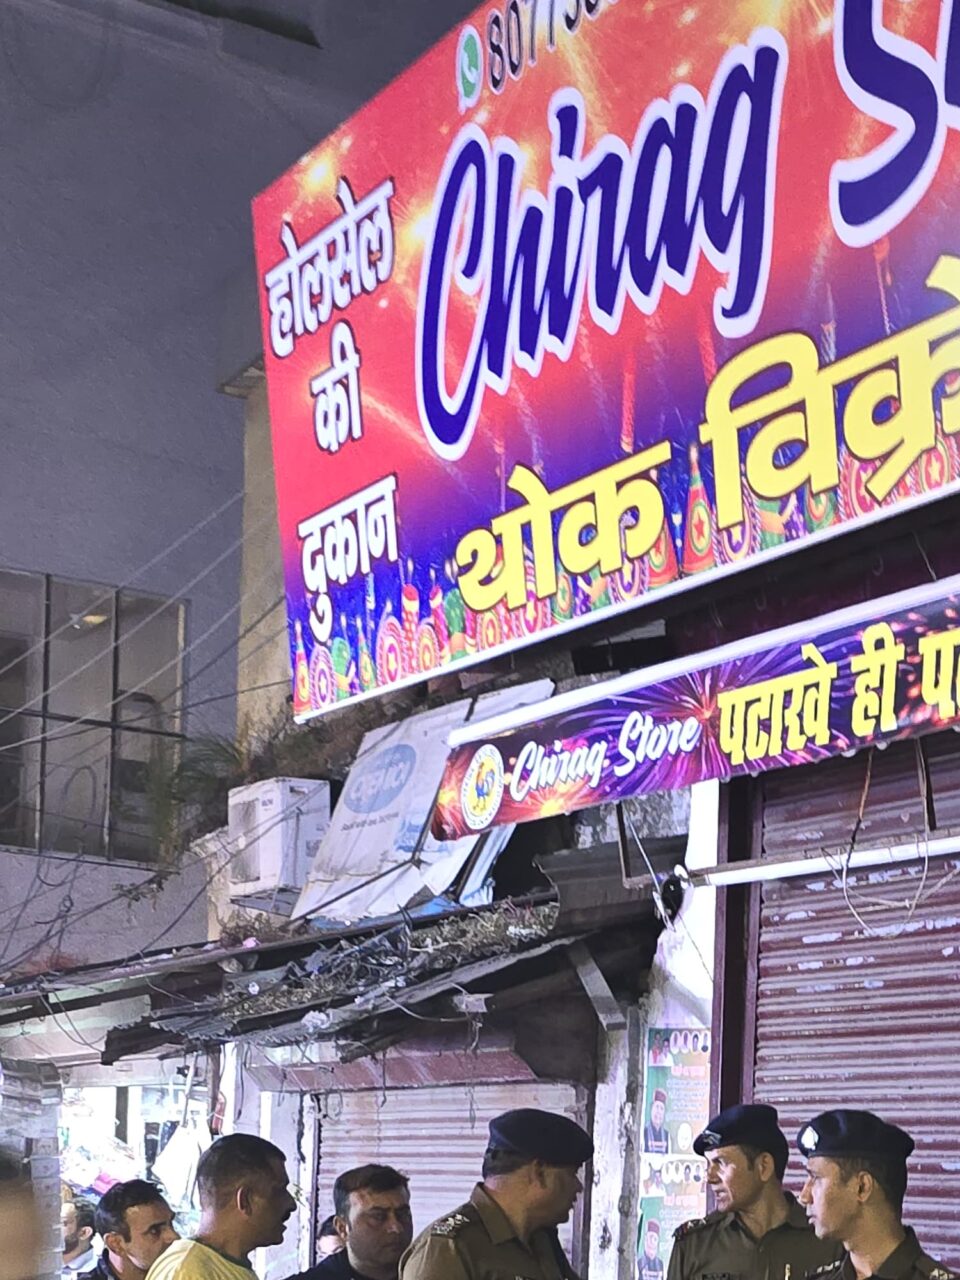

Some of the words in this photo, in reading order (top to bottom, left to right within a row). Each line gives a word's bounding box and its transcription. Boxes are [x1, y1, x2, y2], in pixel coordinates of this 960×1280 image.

[266, 176, 394, 358] होलसेल
[418, 38, 783, 453] Chirag
[311, 321, 361, 454] की
[299, 474, 399, 642] दुकान
[455, 439, 671, 613] थोक
[510, 741, 608, 801] Chirag
[613, 710, 702, 777] Store
[850, 621, 905, 737] ही
